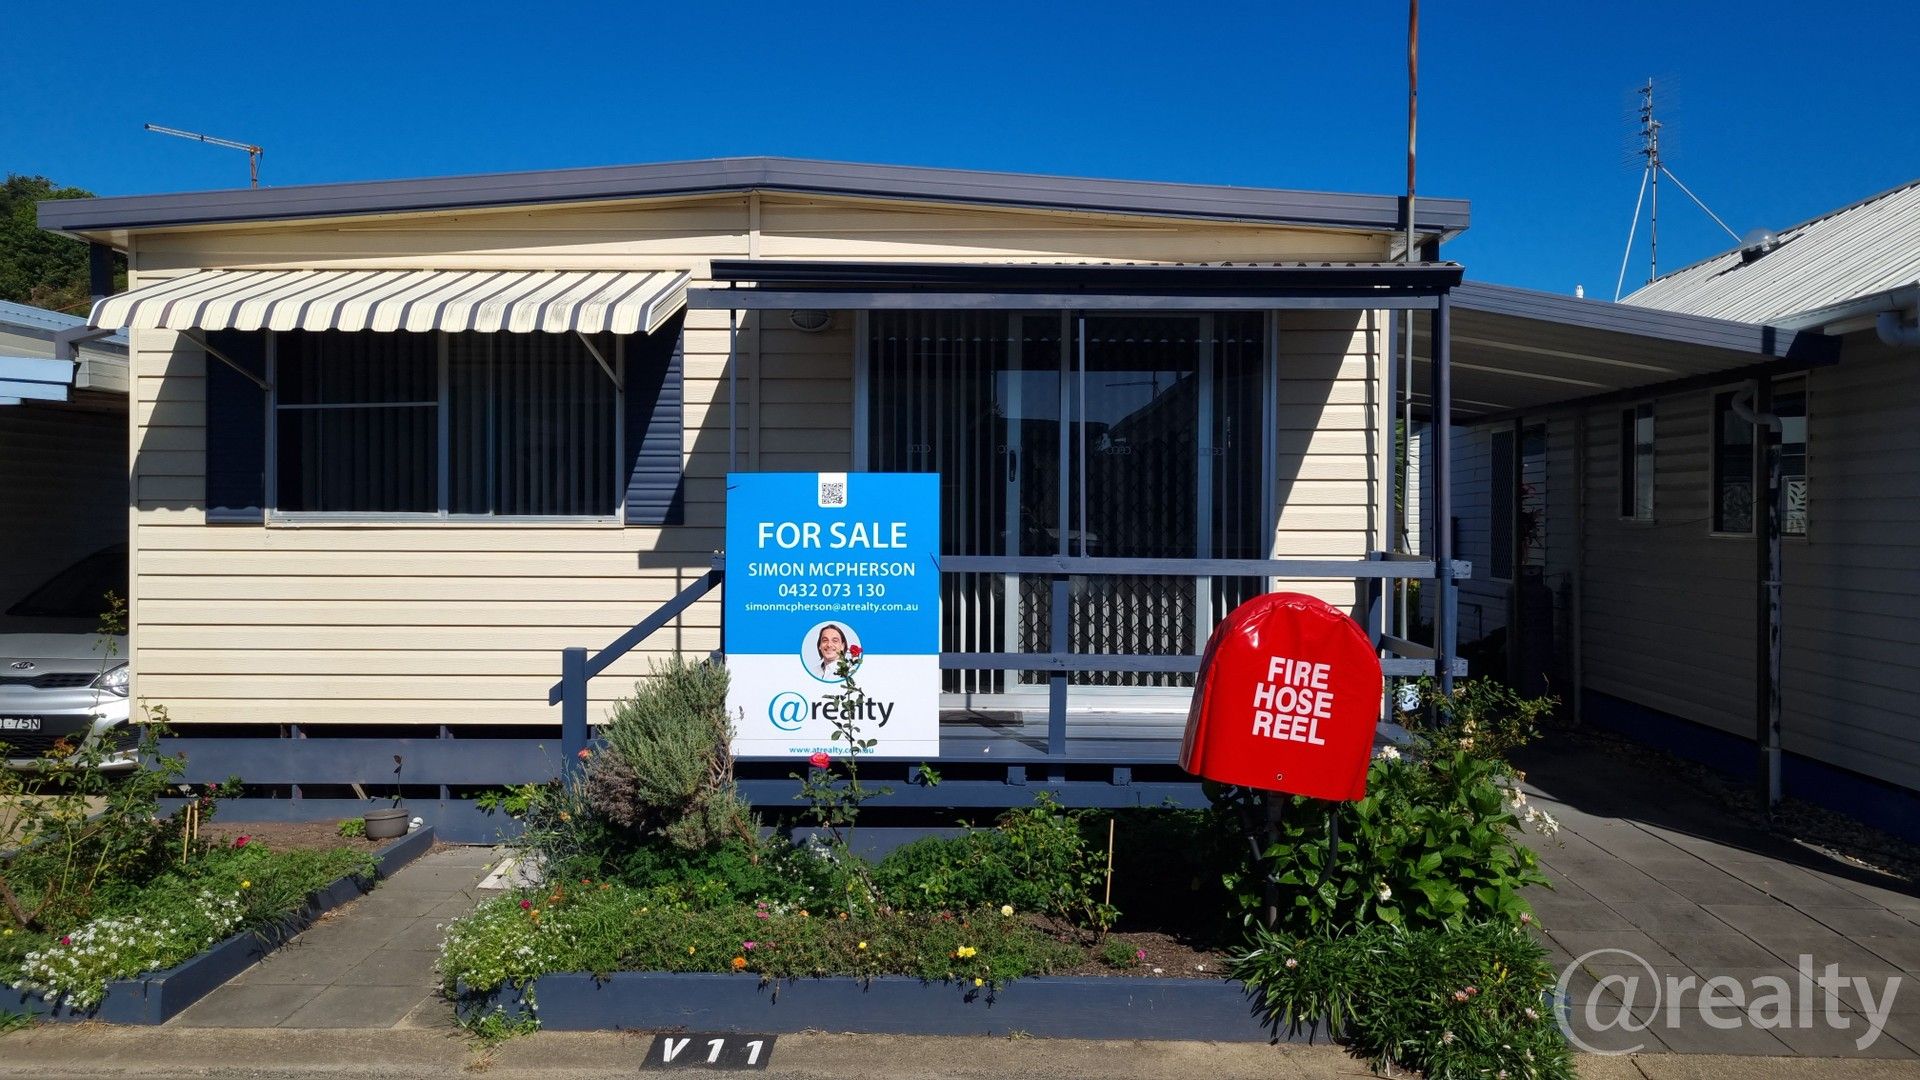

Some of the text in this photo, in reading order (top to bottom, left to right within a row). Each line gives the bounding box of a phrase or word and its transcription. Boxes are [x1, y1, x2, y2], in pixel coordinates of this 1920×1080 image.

[758, 521, 908, 549] FOR SALE
[748, 562, 915, 577] SIMON MCPHERSON
[778, 583, 886, 597] 0432 073 130
[745, 601, 919, 613] simonmcpherson@atrealty.com.au
[1267, 656, 1331, 690] FIRE
[1253, 682, 1334, 719] HOSE
[1252, 710, 1326, 745] REEL
[789, 746, 874, 755] www.atrealty.c.au
